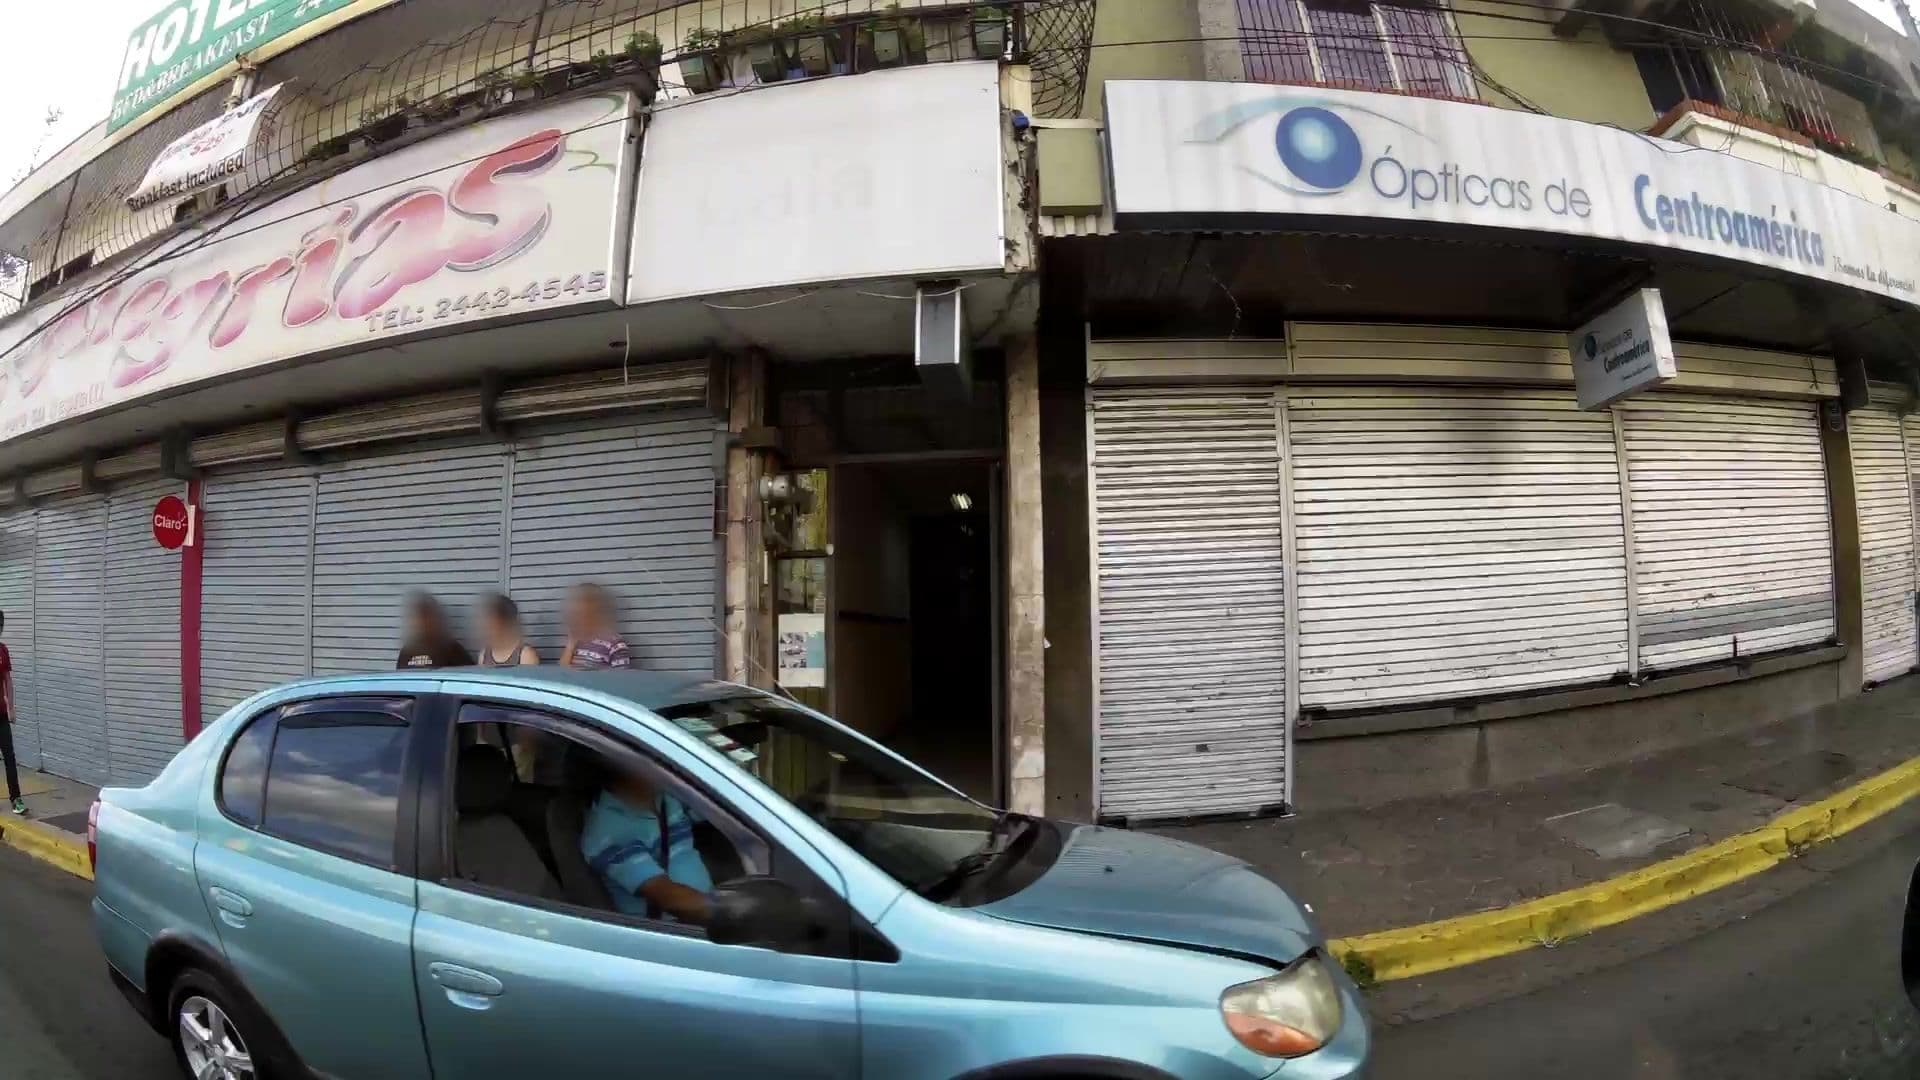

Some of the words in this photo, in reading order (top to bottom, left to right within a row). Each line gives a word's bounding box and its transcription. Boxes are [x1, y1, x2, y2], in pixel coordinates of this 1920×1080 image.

[186, 147, 246, 188] Included
[1370, 144, 1532, 210] Ópticas
[1544, 178, 1592, 218] de
[1634, 173, 1825, 267] Centroamérica
